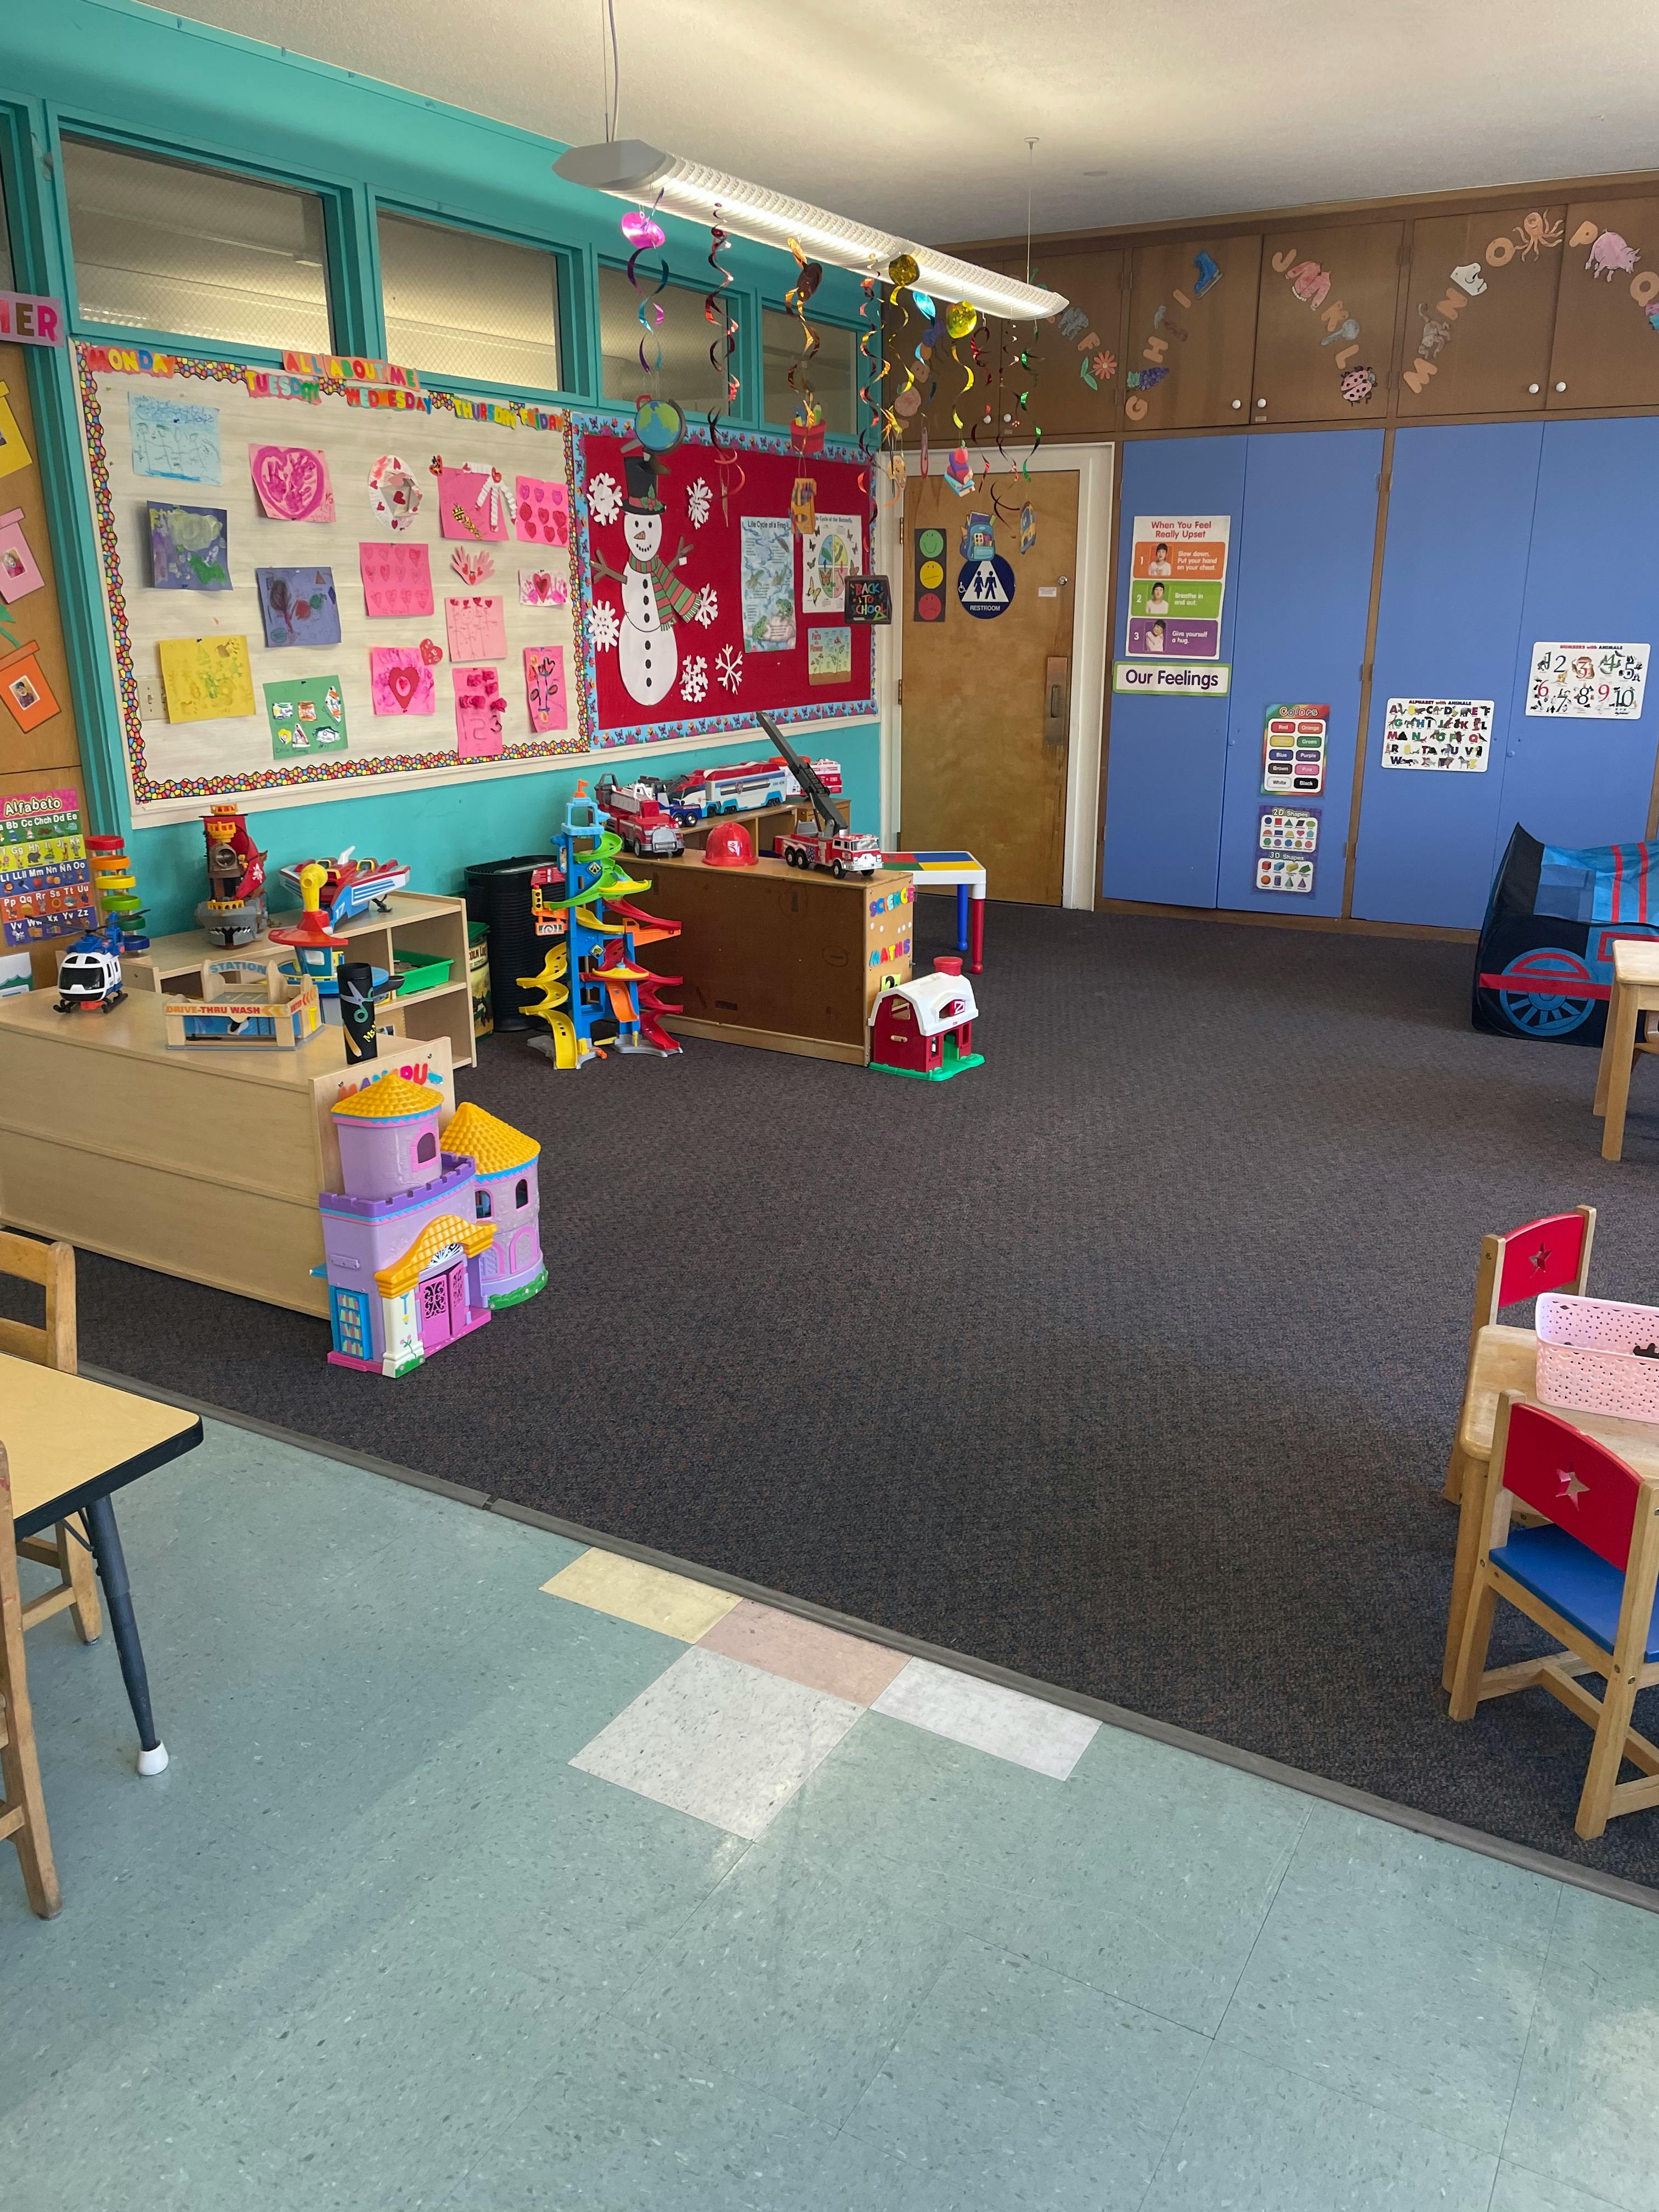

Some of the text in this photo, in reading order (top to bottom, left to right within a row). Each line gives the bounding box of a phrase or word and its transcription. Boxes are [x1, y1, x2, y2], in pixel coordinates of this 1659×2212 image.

[1569, 221, 1599, 247] P
[1485, 237, 1515, 267] O
[1630, 271, 1659, 307] Q
[87, 348, 176, 378] MONDAY
[286, 353, 416, 387] ALL ABOUT ME
[245, 370, 320, 403] TUESDAY
[345, 387, 432, 415] WEDNESDAY
[452, 398, 516, 430] THURSDAY
[521, 408, 564, 432] FRIDAY
[777, 522, 786, 530] Frog
[1152, 521, 1174, 529] When
[1177, 521, 1192, 529] You
[1155, 530, 1206, 539] Really Upset
[1140, 556, 1144, 565] 1
[854, 583, 879, 595] BACK
[861, 594, 874, 603] TO
[1136, 595, 1142, 603] 2
[852, 605, 887, 616] SCHOOL
[1134, 632, 1139, 640] 3
[1553, 655, 1566, 673] 2
[1576, 661, 1588, 679] 3
[1604, 654, 1616, 672] 4
[1623, 662, 1635, 680] 5
[1126, 669, 1218, 690] Our Feelings
[1538, 679, 1549, 697] 6
[1577, 687, 1590, 705] 8
[1598, 684, 1610, 702] 9
[1614, 689, 1634, 708] 10
[1279, 707, 1318, 716] Colors
[1390, 705, 1397, 713] A
[1426, 706, 1433, 714] C
[1444, 707, 1452, 715] D
[1471, 707, 1478, 715] E
[1556, 695, 1568, 713] 7
[1394, 719, 1402, 727] G
[1417, 719, 1425, 727] H
[1460, 721, 1469, 729] K
[1481, 721, 1487, 730] L
[1387, 731, 1397, 740] M
[1412, 732, 1421, 740] N
[1469, 734, 1478, 743] Q
[1421, 746, 1429, 754] T
[1390, 756, 1402, 764] W
[5, 797, 61, 817] Alfabeto
[6, 821, 19, 830] Bb
[34, 816, 52, 826] Chch
[53, 814, 65, 822] Dd
[66, 812, 77, 821] Ee
[11, 847, 24, 855] Gg
[57, 839, 64, 849] Jj
[29, 869, 43, 877] Mm
[59, 864, 72, 873] Ññ
[73, 861, 86, 870] Oo
[4, 898, 16, 907] Pp
[19, 895, 32, 904] Qq
[36, 893, 46, 901] Rr
[335, 901, 346, 917] 17
[869, 886, 916, 917] SCIENCE
[10, 922, 22, 930] Vv
[78, 909, 89, 917] Zz
[869, 939, 910, 966] MATHS
[210, 962, 267, 975] STATION
[166, 1006, 227, 1014] DRIVE-THRU
[291, 1000, 302, 1013] ENTER
